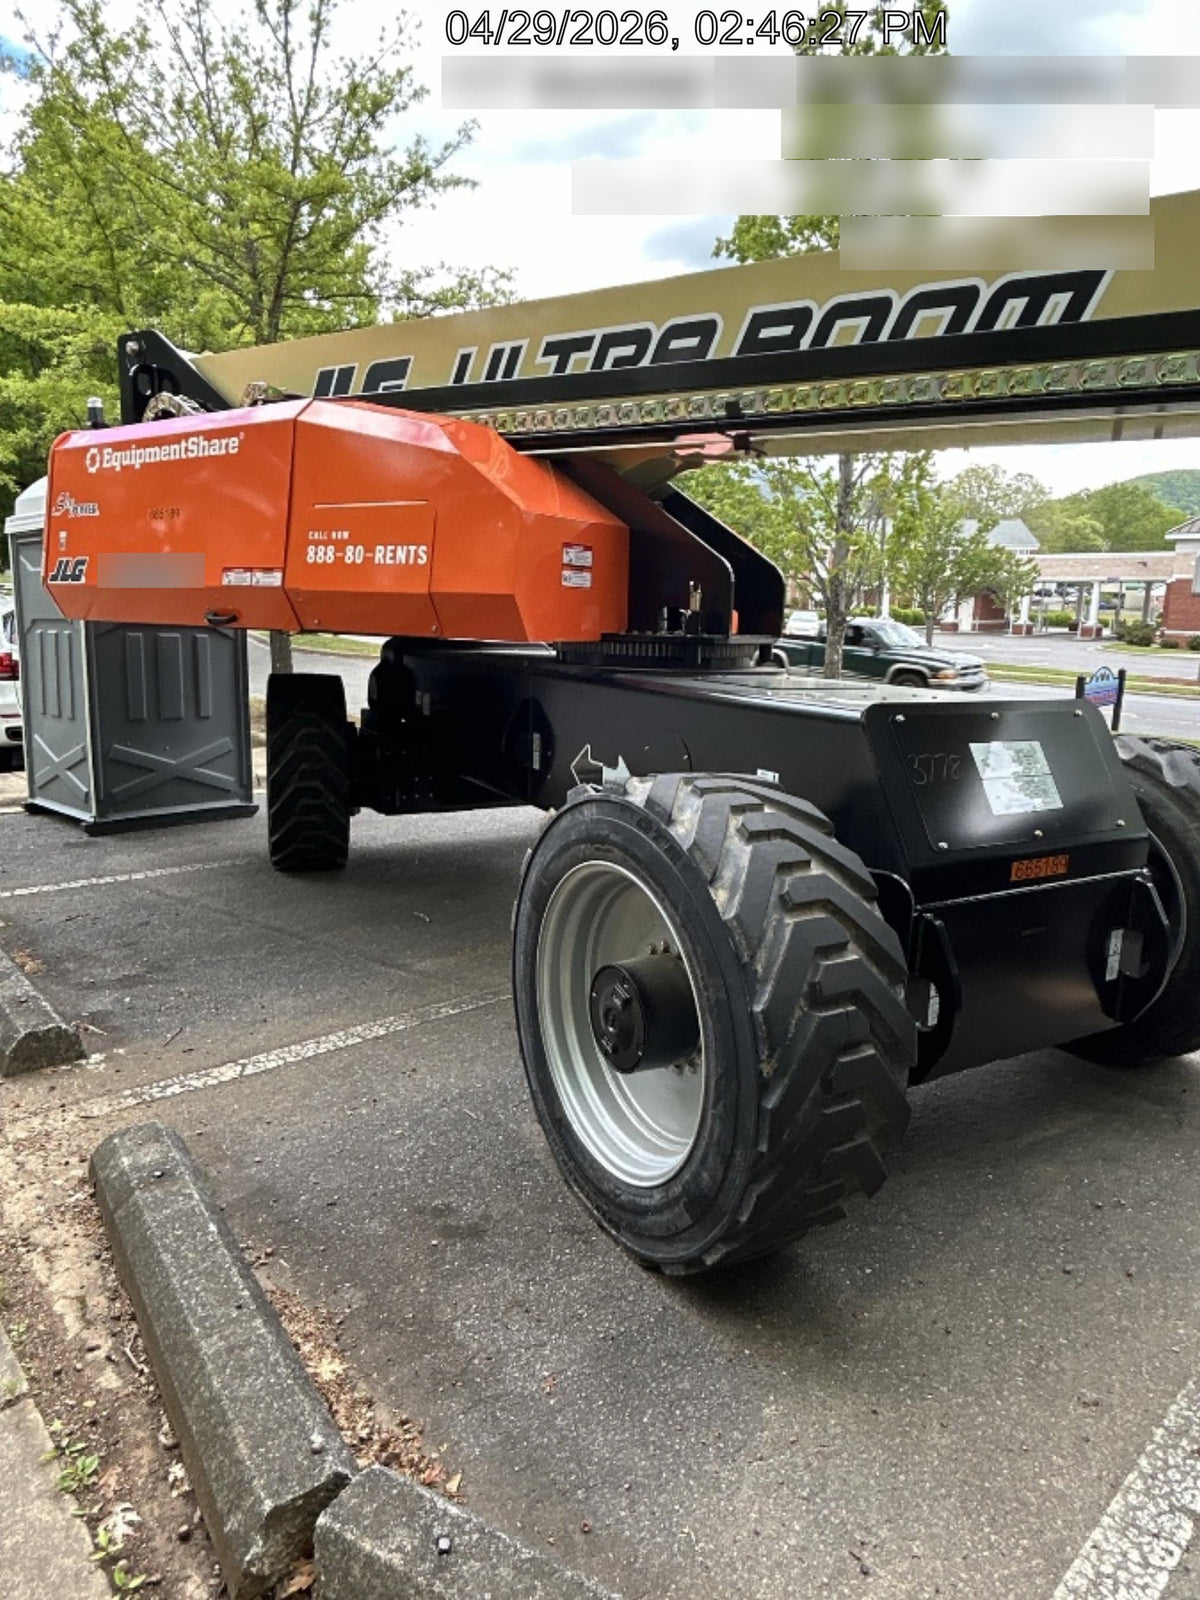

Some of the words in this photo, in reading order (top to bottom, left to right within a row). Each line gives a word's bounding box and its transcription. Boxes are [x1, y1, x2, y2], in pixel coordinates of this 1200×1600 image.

[102, 436, 239, 471] EquipmentShare
[308, 530, 328, 540] CALL
[306, 544, 428, 565] 888-80-RENTS
[49, 557, 88, 583] JLG
